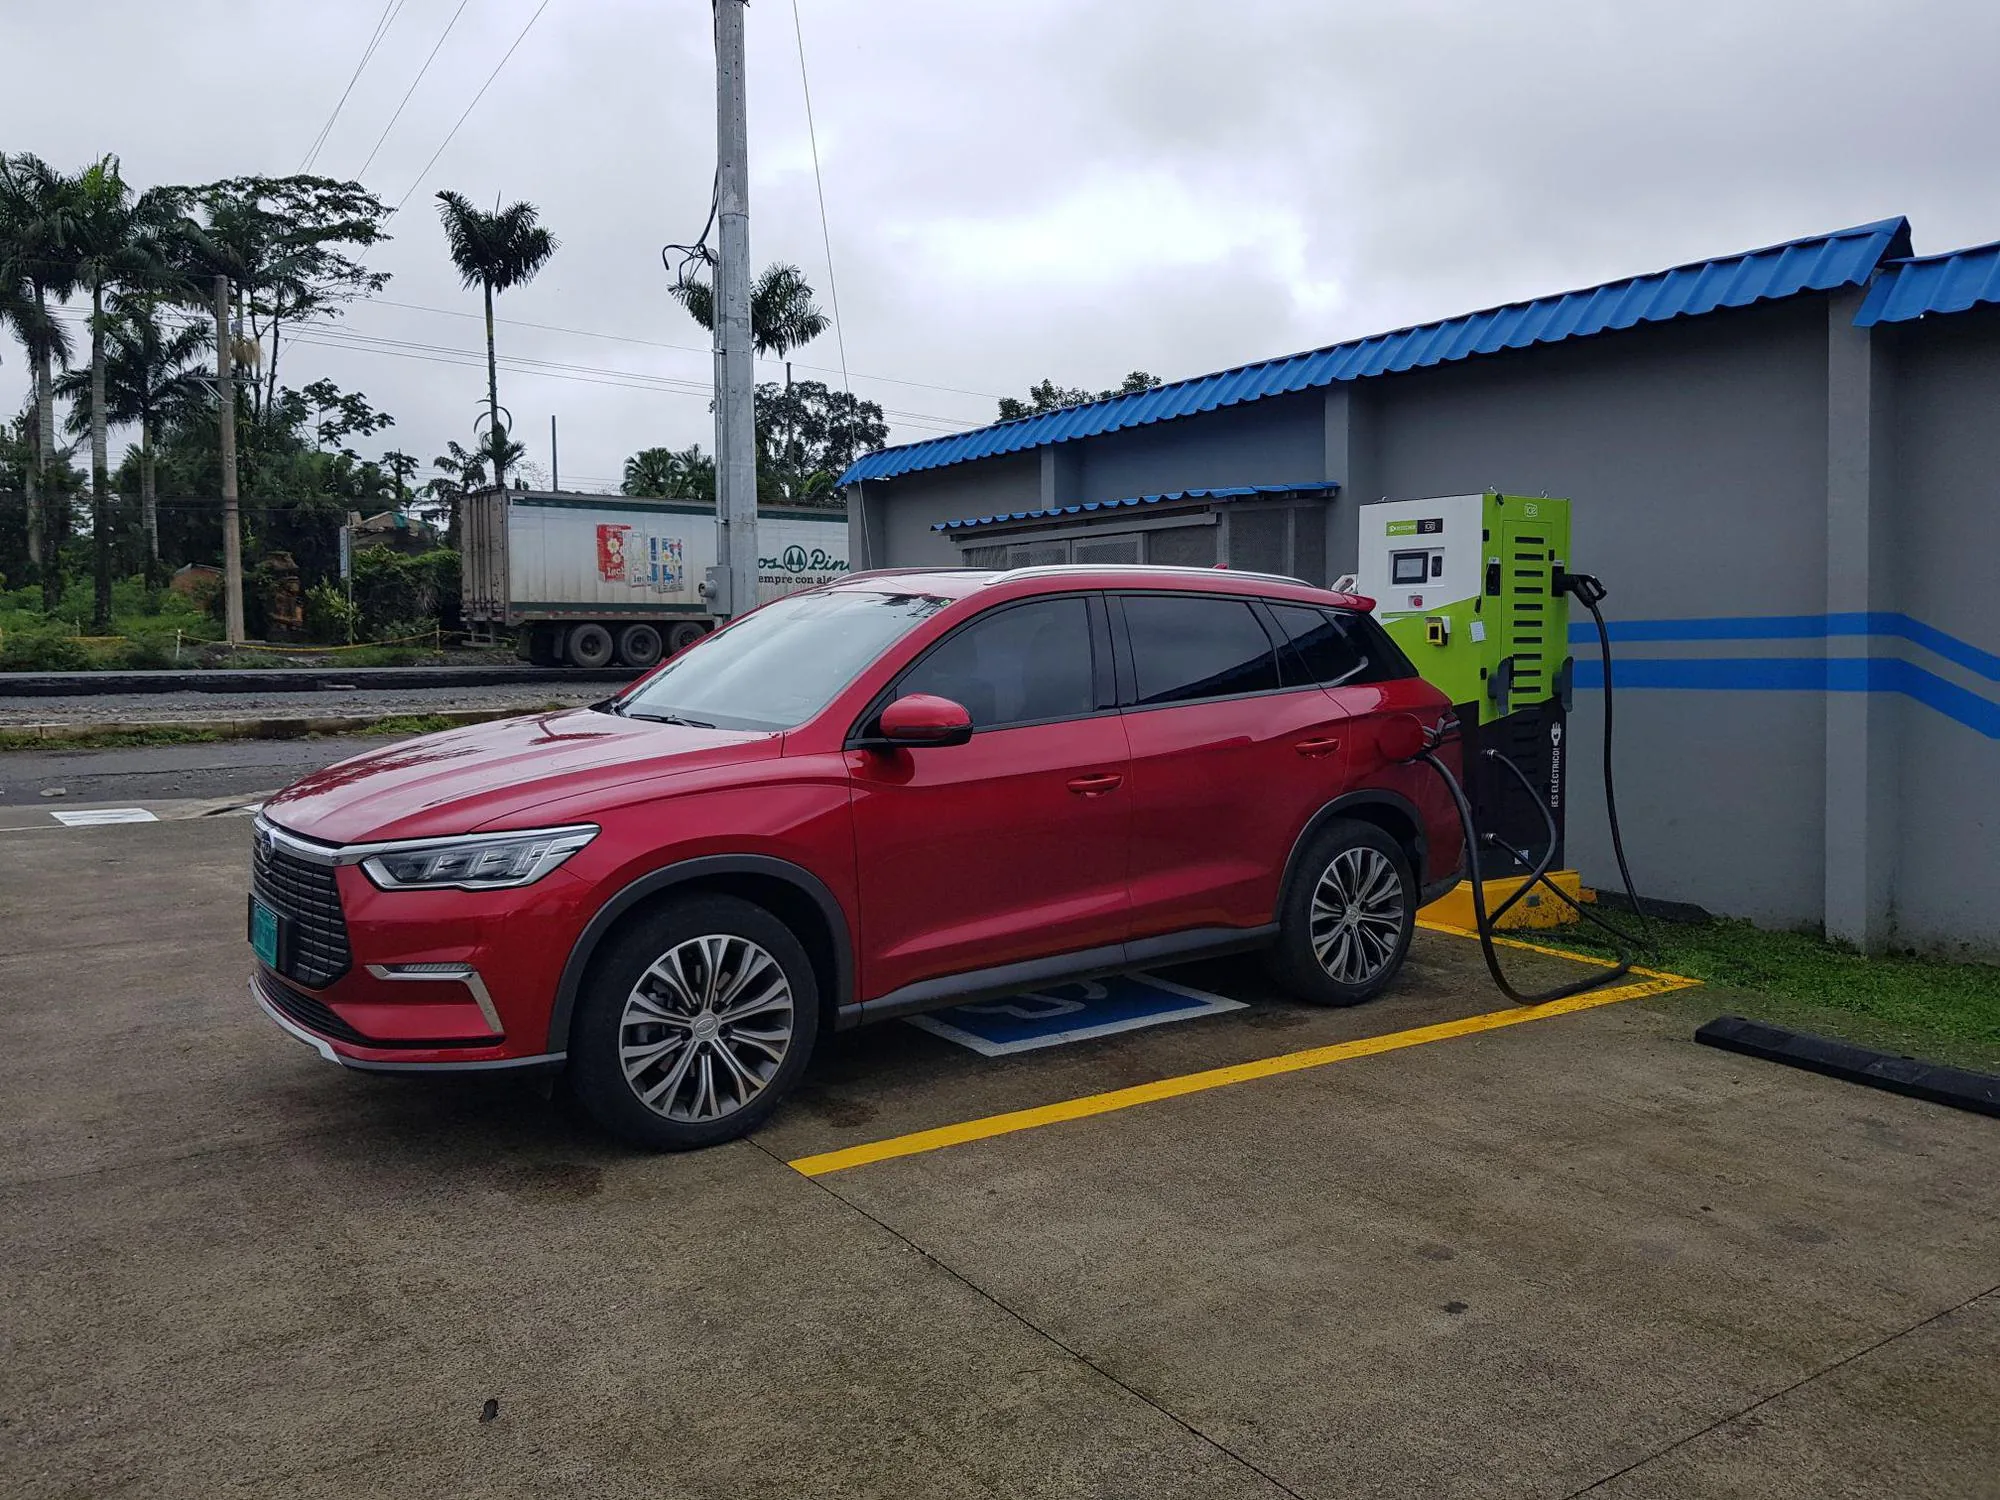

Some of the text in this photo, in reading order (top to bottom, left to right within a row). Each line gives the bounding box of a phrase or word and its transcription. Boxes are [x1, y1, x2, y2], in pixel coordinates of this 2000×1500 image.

[758, 548, 850, 571] os Pin
[758, 575, 839, 585] empre con alg
